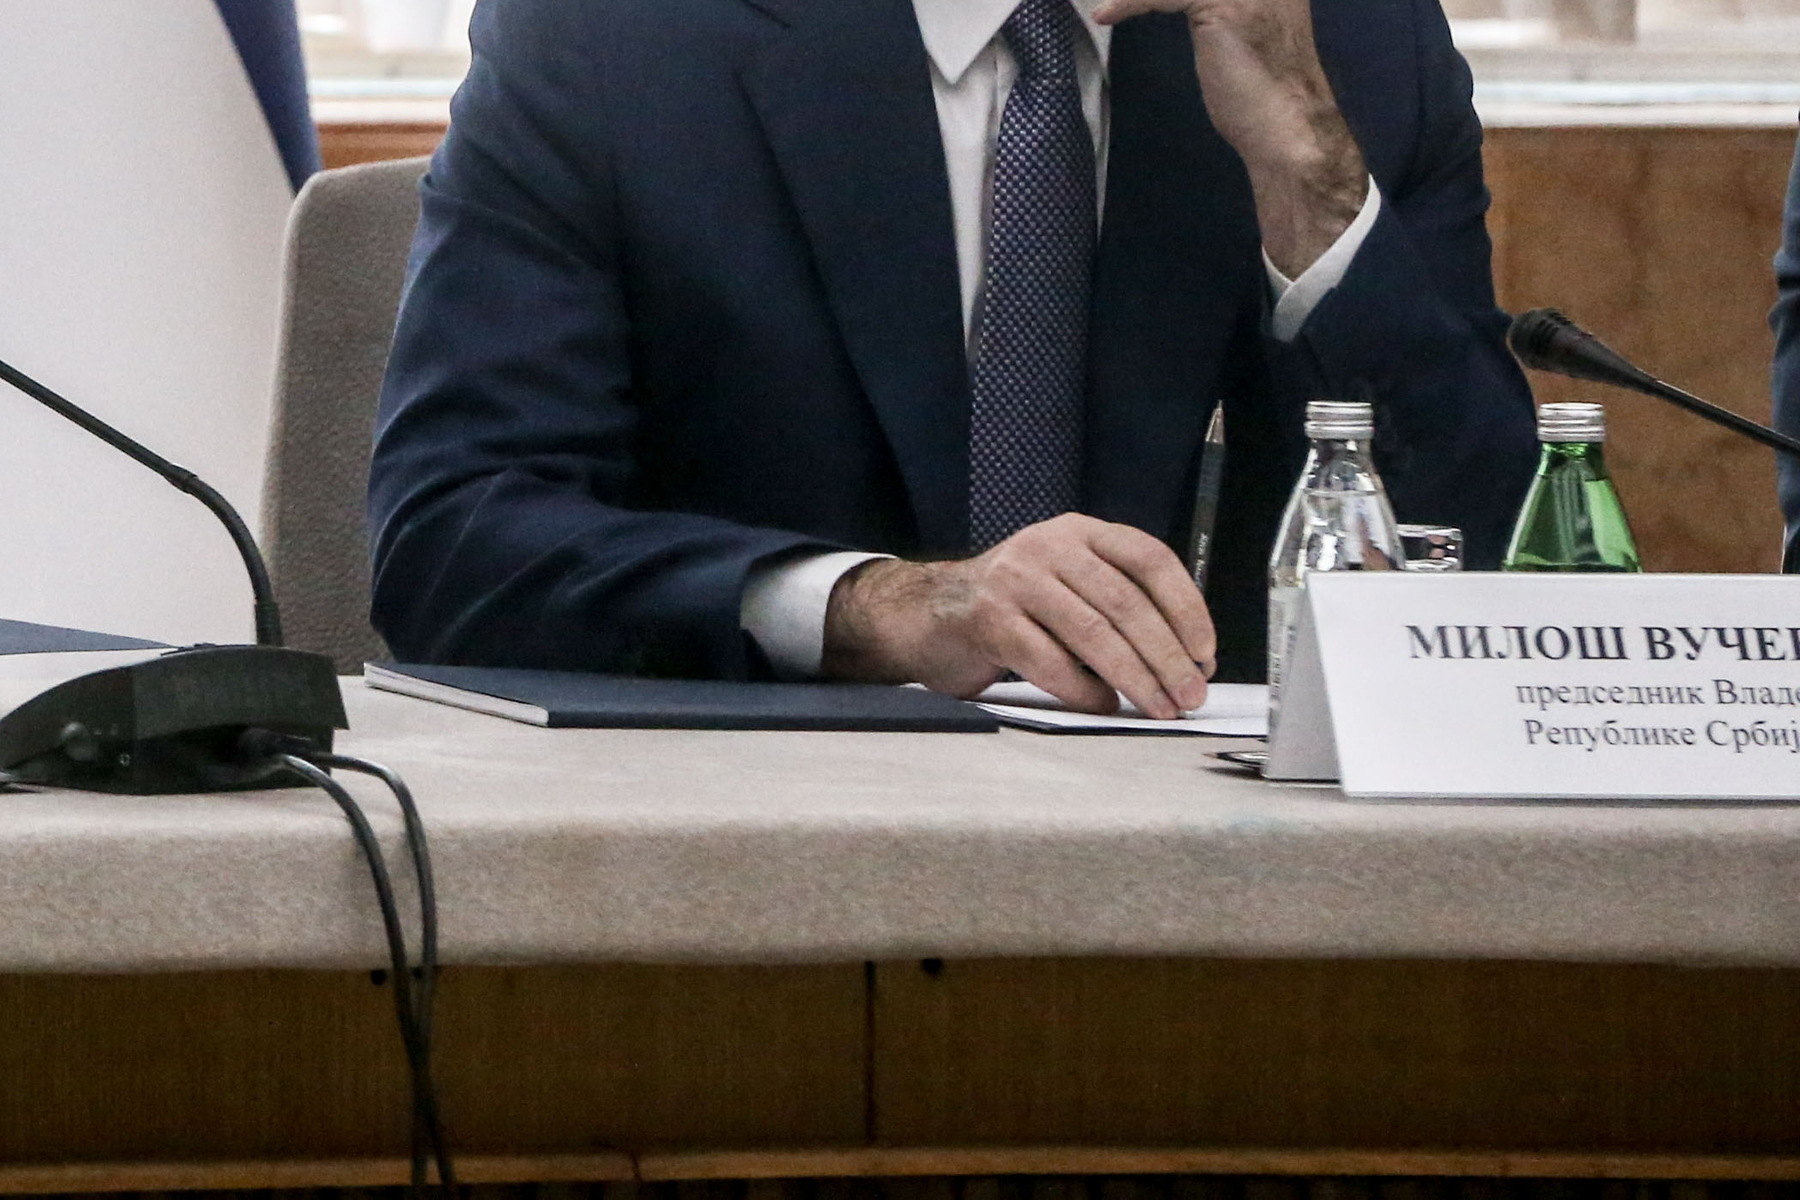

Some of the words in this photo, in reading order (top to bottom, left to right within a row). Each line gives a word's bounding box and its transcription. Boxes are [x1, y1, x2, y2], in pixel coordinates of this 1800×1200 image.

[1404, 625, 1630, 660] МИЛОШ
[1515, 684, 1705, 711] председник
[1523, 718, 1696, 752] Републике
